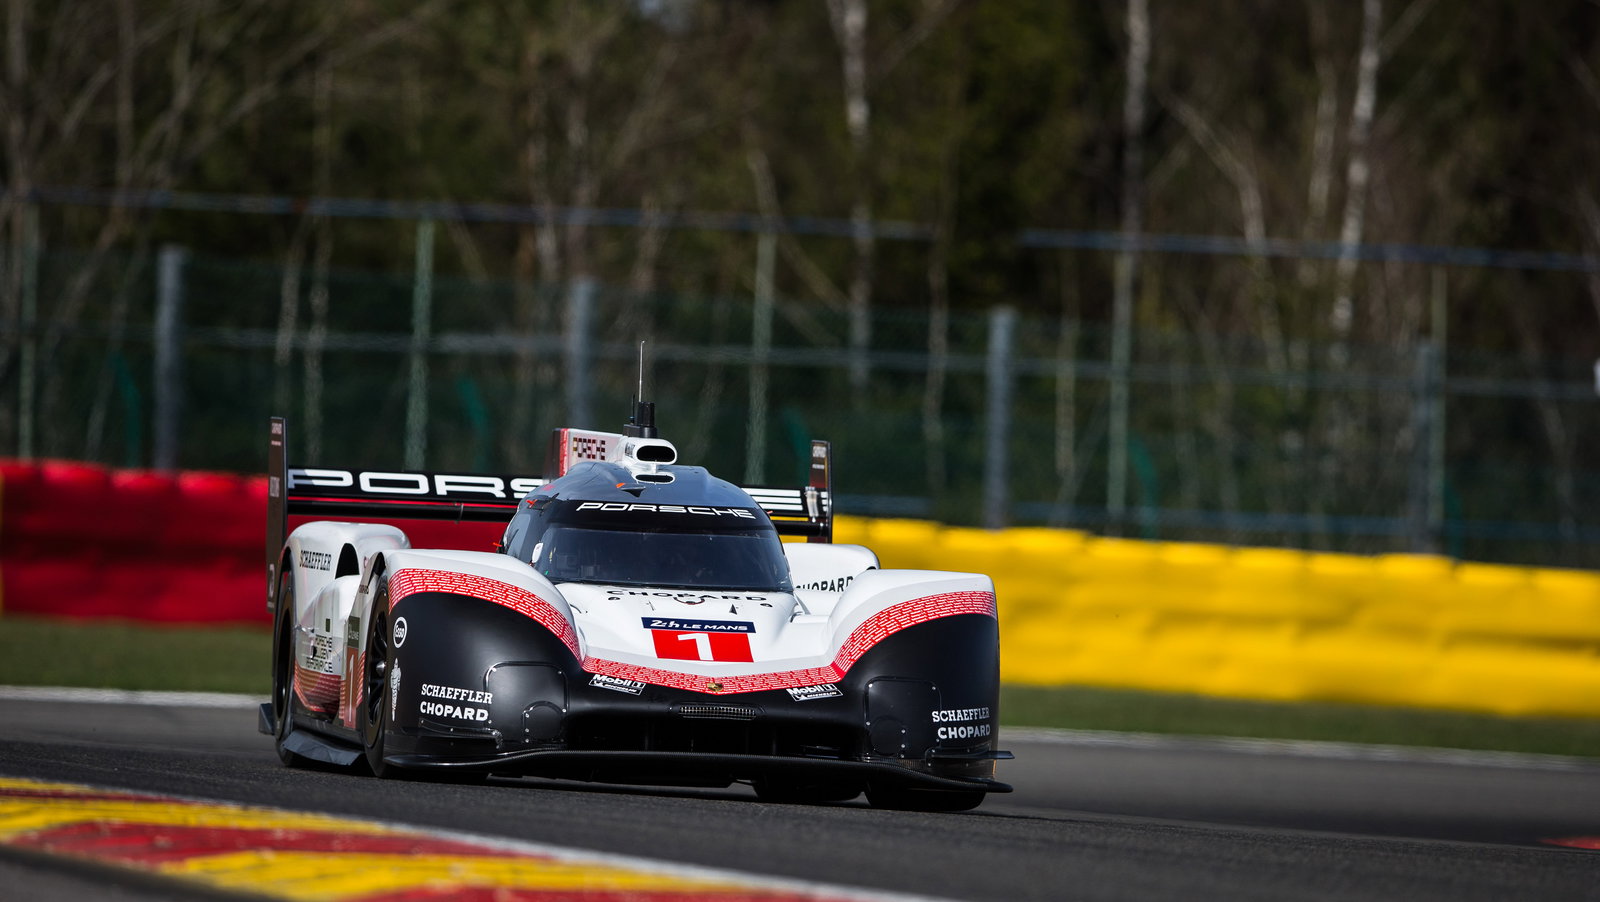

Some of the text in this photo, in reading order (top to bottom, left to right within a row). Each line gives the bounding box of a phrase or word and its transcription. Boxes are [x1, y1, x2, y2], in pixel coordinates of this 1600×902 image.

[575, 502, 757, 520] PORSCHE
[299, 549, 332, 571] SCHAEFFLER
[606, 590, 767, 602] CHOPARD
[703, 623, 748, 631] MANS
[677, 632, 715, 661] 1
[593, 673, 633, 688] Mobil
[420, 683, 493, 705] SCHAEFFLER
[785, 684, 825, 696] Mobil
[420, 701, 489, 721] CHOPARD
[931, 706, 991, 723] SCHAEFFLER
[937, 724, 991, 740] CHOPARD
